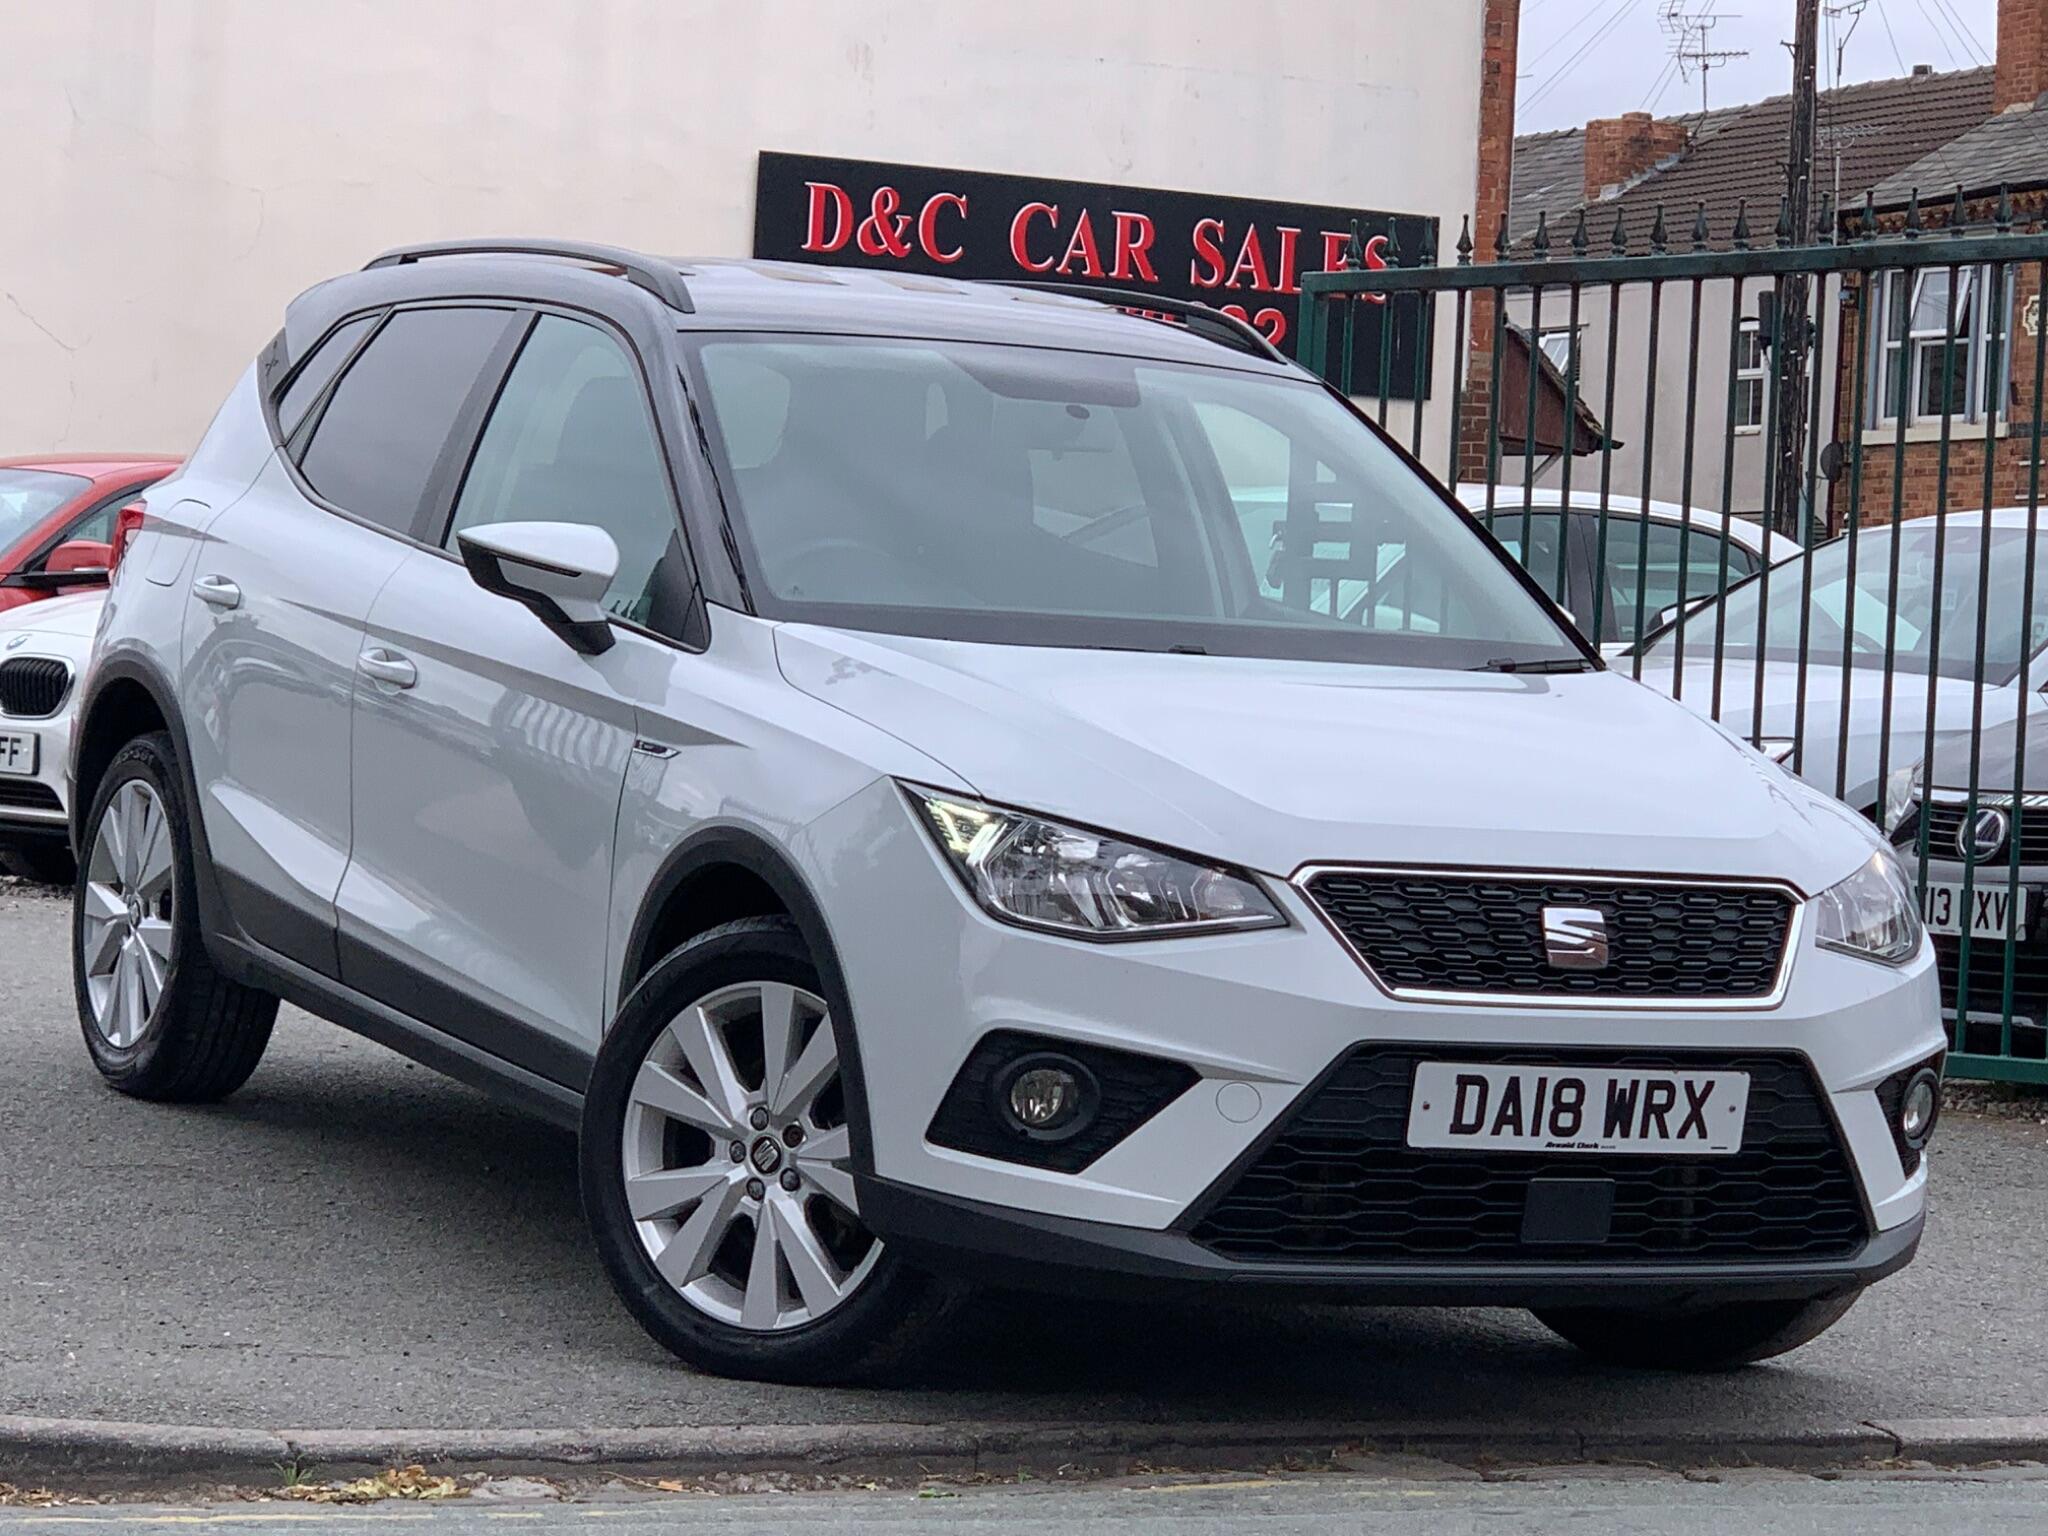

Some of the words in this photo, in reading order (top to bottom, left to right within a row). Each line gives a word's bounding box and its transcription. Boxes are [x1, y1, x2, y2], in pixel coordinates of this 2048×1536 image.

[802, 181, 967, 263] D&C
[1009, 202, 1158, 283] CAR
[1449, 1073, 1586, 1138] DA18
[1603, 1078, 1716, 1140] WRX
